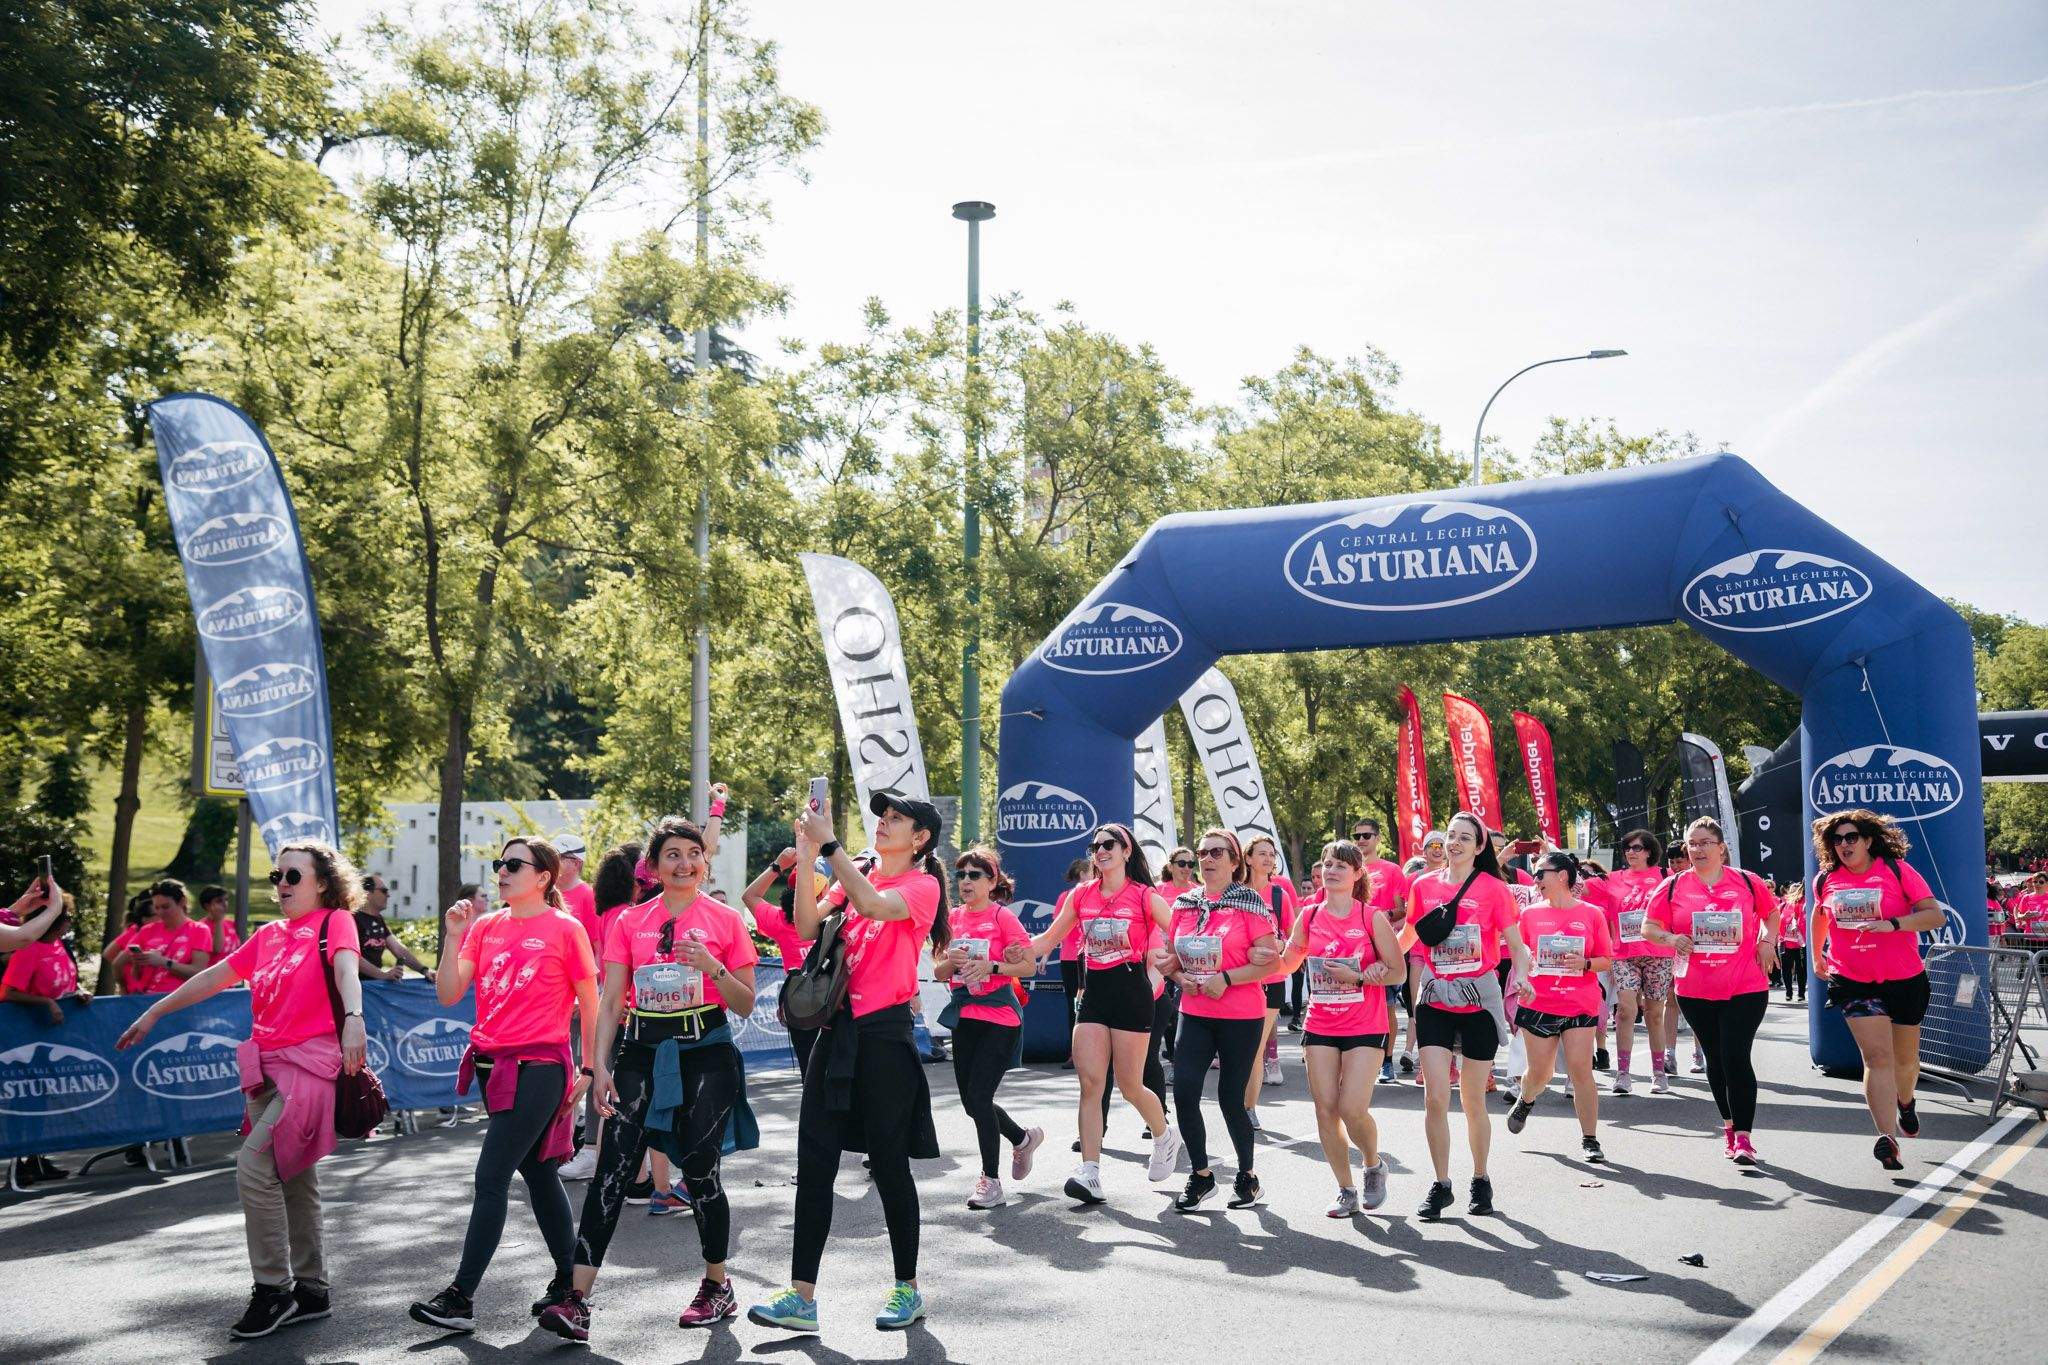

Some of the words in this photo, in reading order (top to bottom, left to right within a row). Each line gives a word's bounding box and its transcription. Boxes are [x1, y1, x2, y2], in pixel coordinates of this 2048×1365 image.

[1341, 532, 1418, 548] CENTRAL
[1426, 524, 1508, 541] LECHERA
[1303, 540, 1519, 587] ASTURIANA
[1715, 576, 1777, 593] CENTRAL
[1783, 570, 1849, 582] LECHERA
[1700, 580, 1859, 617] ASTURIANA
[1069, 627, 1110, 636] CENTRAL
[1114, 625, 1165, 634] LECHERA
[1046, 636, 1172, 659] ASTURIANA
[1834, 772, 1888, 781] CENTRAL
[1893, 770, 1949, 779] LECHERA
[1816, 776, 1954, 805] ASTURIANA
[1039, 803, 1084, 811] LECHERA
[1709, 929, 1727, 937] 016
[1190, 957, 1207, 965] 016
[656, 991, 680, 1003] 016
[145, 1060, 240, 1086] ASTURIAN
[0, 1073, 110, 1099] STURIANA
